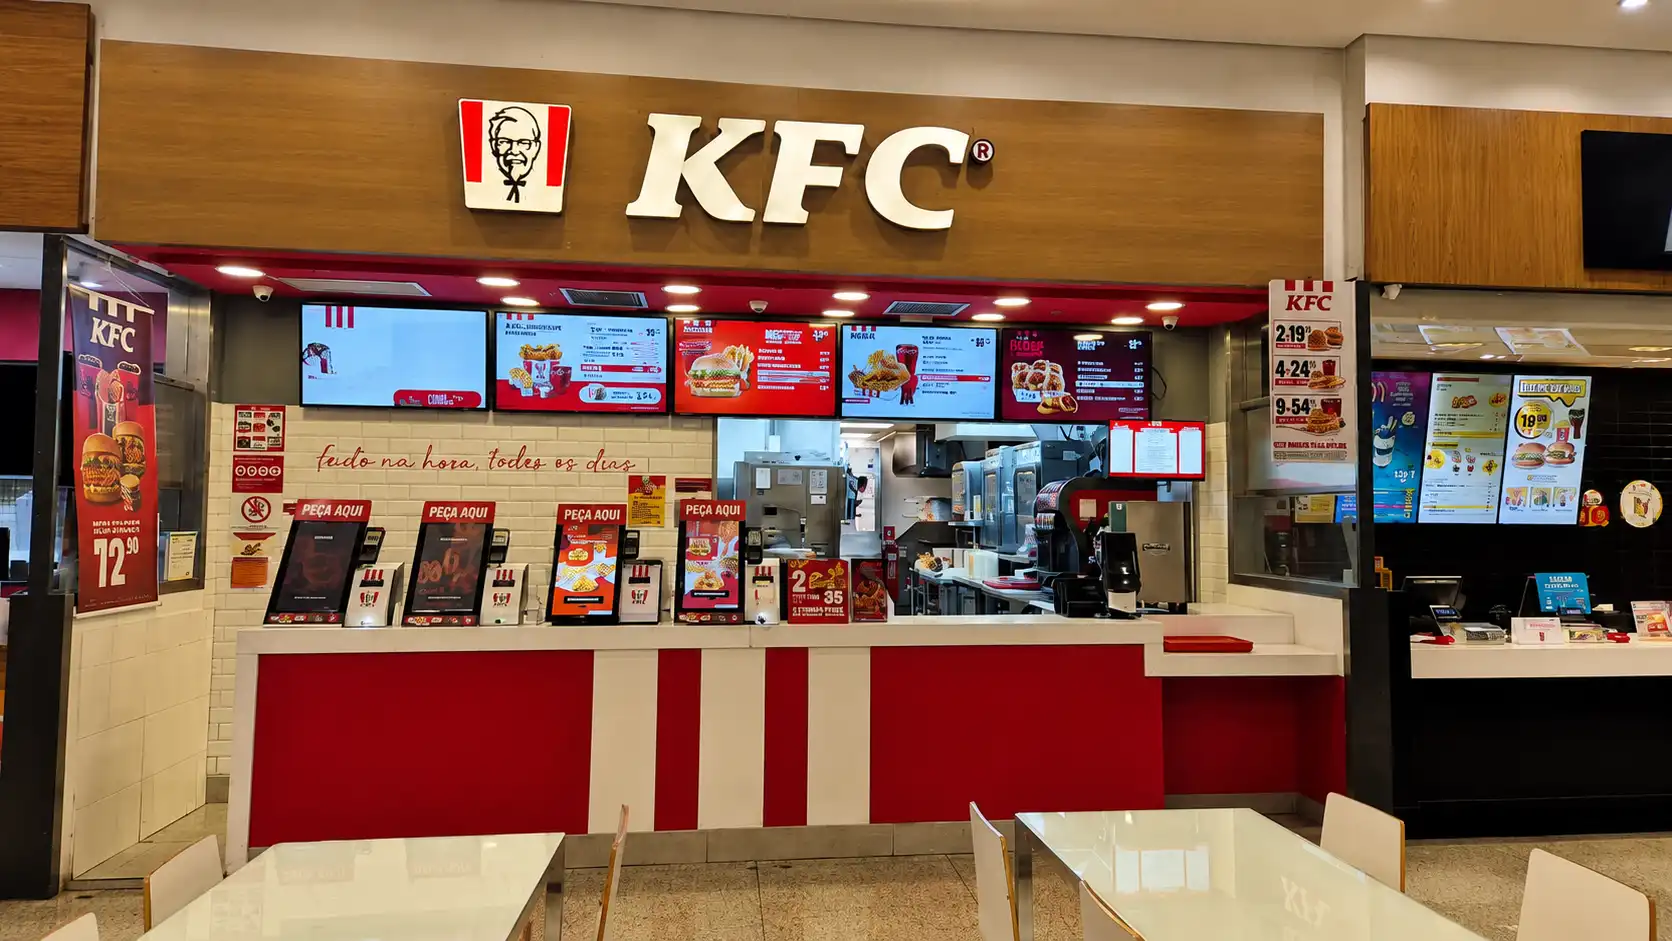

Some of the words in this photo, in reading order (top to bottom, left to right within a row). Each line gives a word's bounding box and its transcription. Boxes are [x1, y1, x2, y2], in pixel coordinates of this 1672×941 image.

[625, 113, 969, 229] KFC
[1285, 294, 1333, 312] KFC
[89, 316, 136, 353] KFC
[381, 457, 416, 469] na
[422, 444, 479, 472] hora,
[586, 448, 636, 473] dias
[301, 503, 332, 518] PEÇA
[334, 504, 364, 517] AQUI
[429, 506, 458, 521] PEÇA
[460, 507, 489, 519] AQUI
[564, 509, 592, 523] PEÇA
[594, 509, 621, 522] AQUI
[686, 504, 713, 517] PEÇA
[715, 504, 741, 516] AQUI
[93, 537, 126, 588] 72
[126, 536, 139, 554] 90
[791, 569, 807, 593] 2
[823, 590, 844, 605] 35
